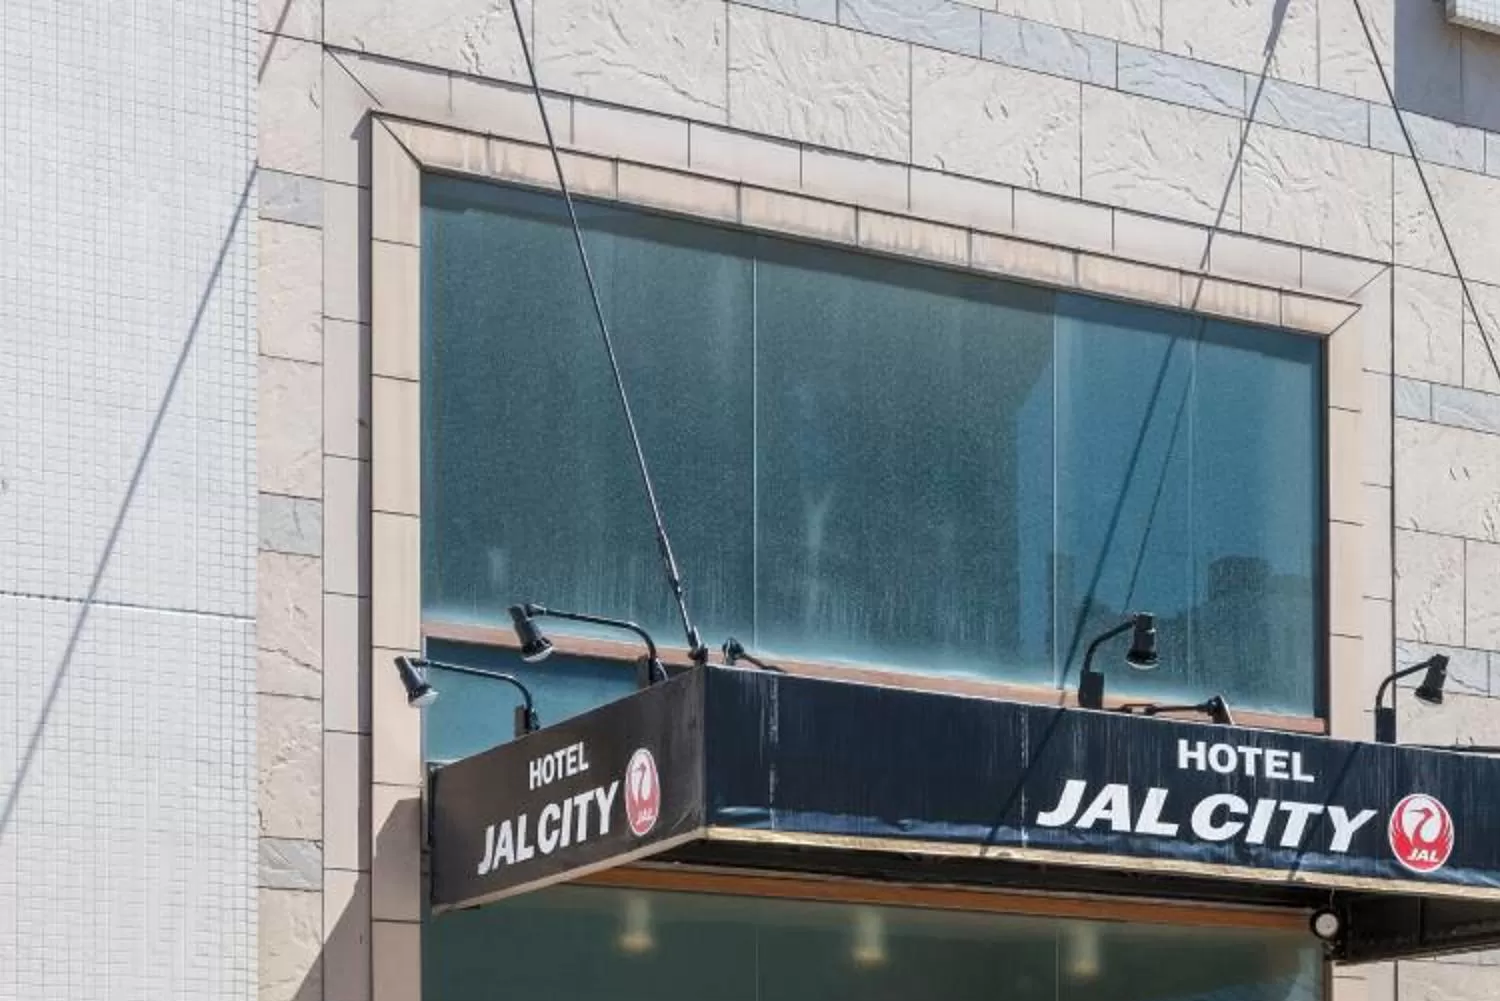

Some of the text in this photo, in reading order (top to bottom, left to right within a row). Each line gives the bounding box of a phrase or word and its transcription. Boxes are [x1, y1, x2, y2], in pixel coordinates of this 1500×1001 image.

[529, 741, 589, 791] HOTEL
[1177, 738, 1315, 782] HOTEL
[477, 779, 620, 876] JAL CITY
[1036, 779, 1378, 852] JAL CITY
[1407, 847, 1440, 863] JAL
